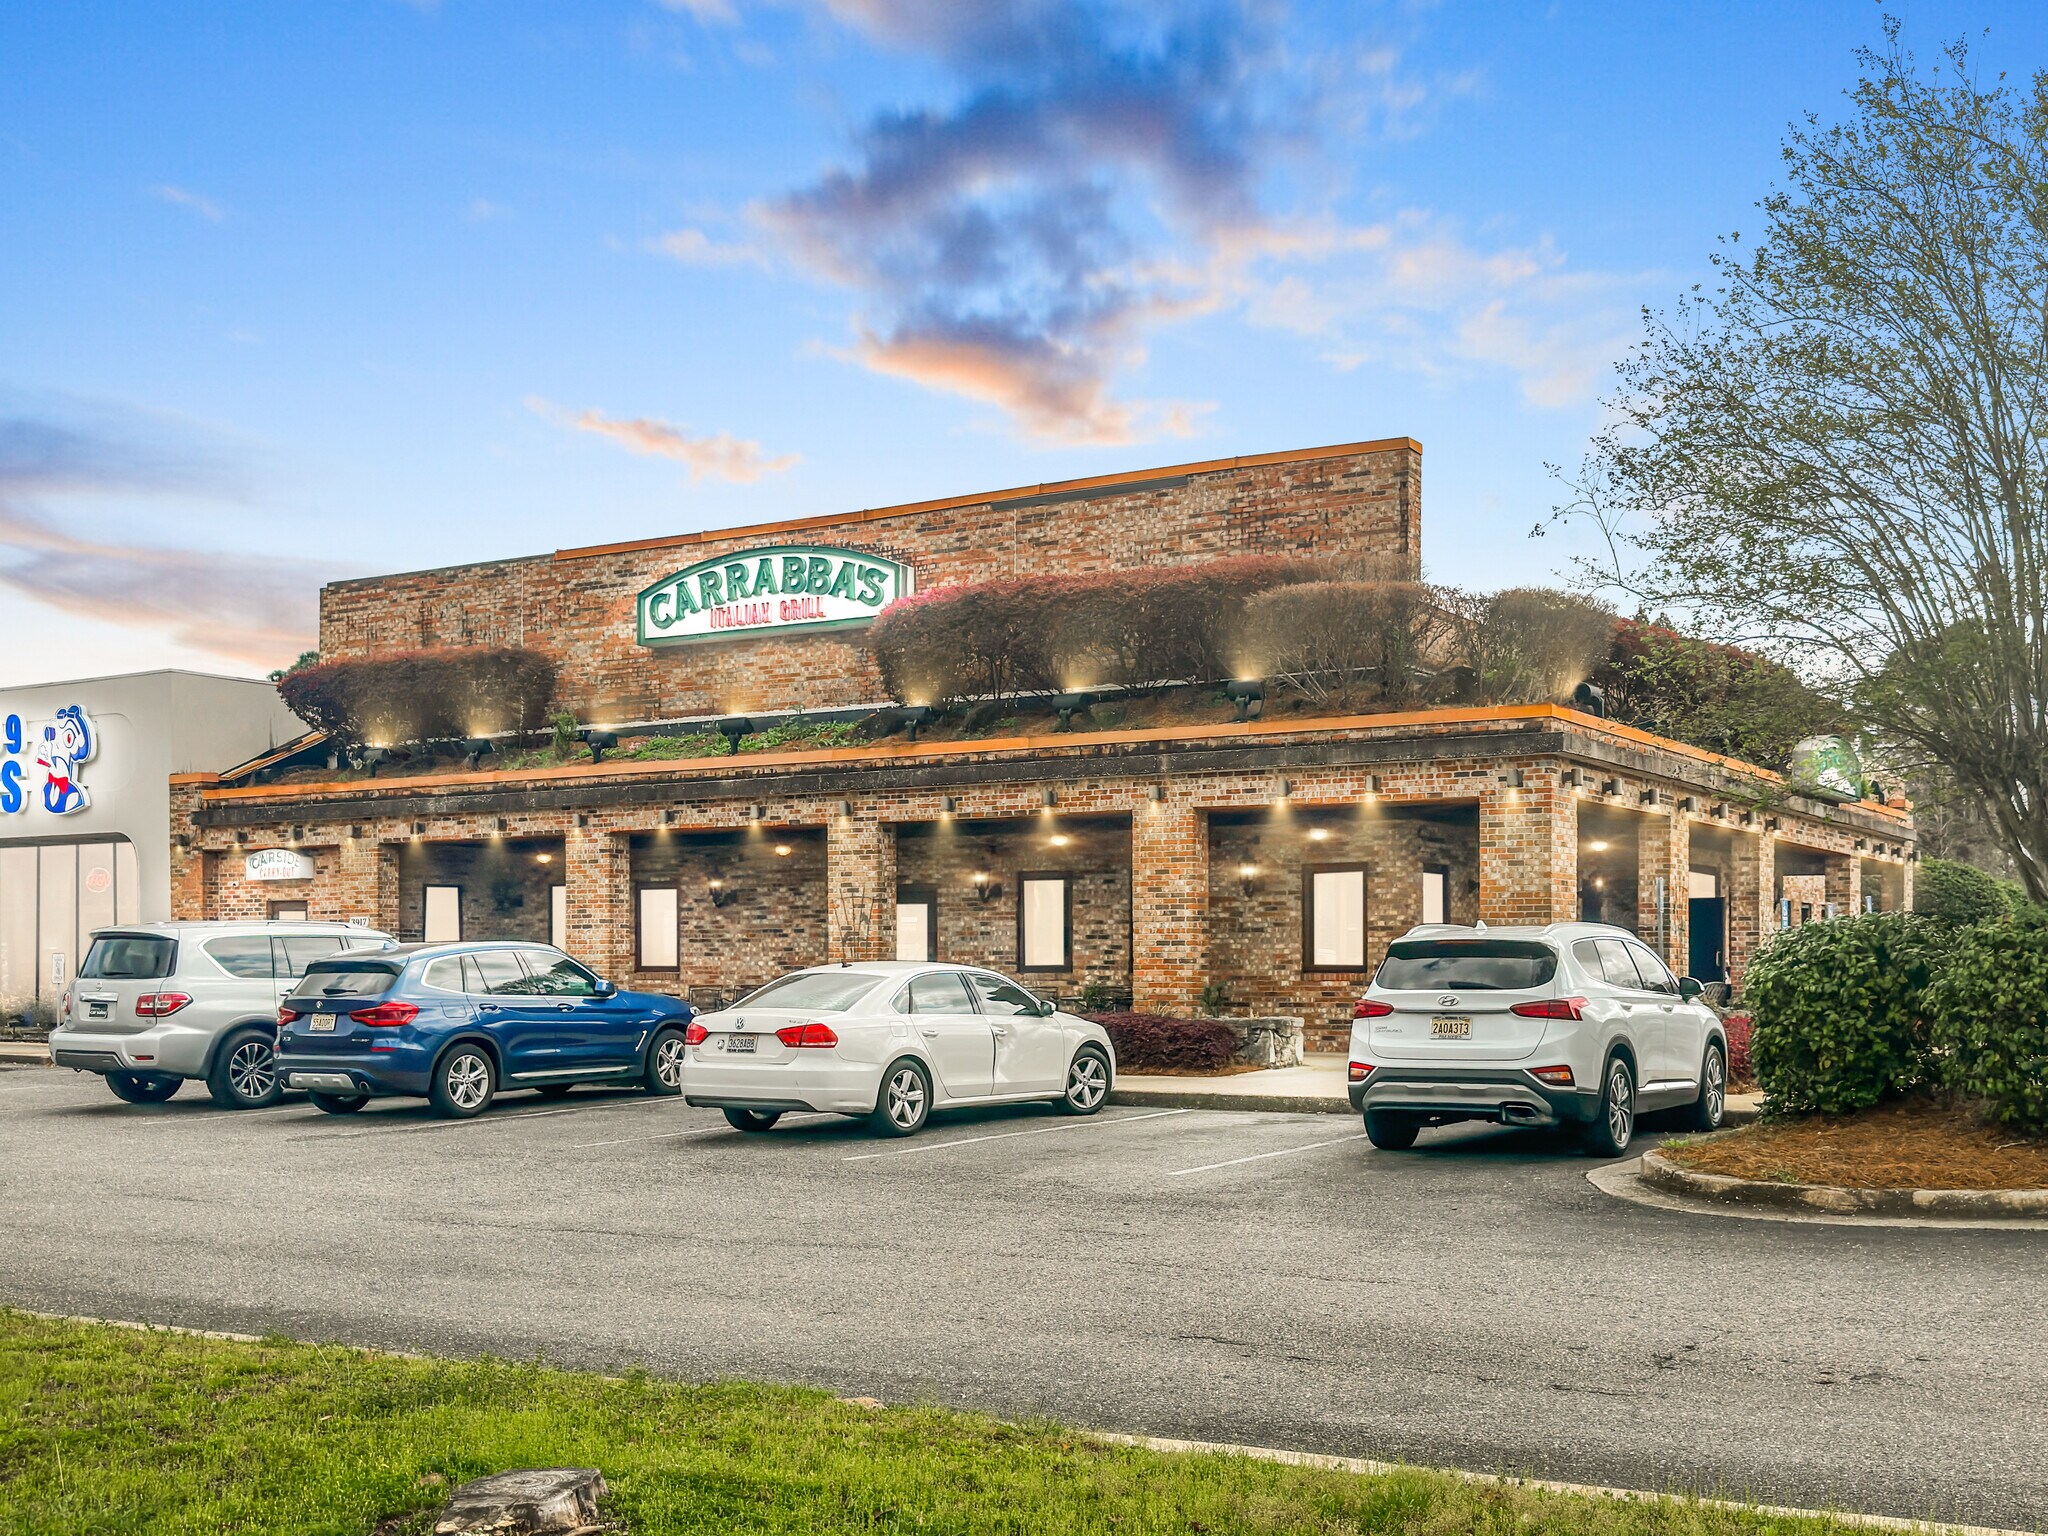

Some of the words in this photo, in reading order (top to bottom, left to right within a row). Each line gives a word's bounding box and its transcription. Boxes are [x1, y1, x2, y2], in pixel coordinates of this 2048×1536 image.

[649, 555, 889, 630] CARRABBA'S
[710, 602, 772, 629] ITALIAN
[780, 596, 826, 621] GRILL
[249, 851, 301, 869] CARSIDE
[259, 866, 295, 878] CARRY-OUT
[1433, 1022, 1469, 1034] 2A0A3T3
